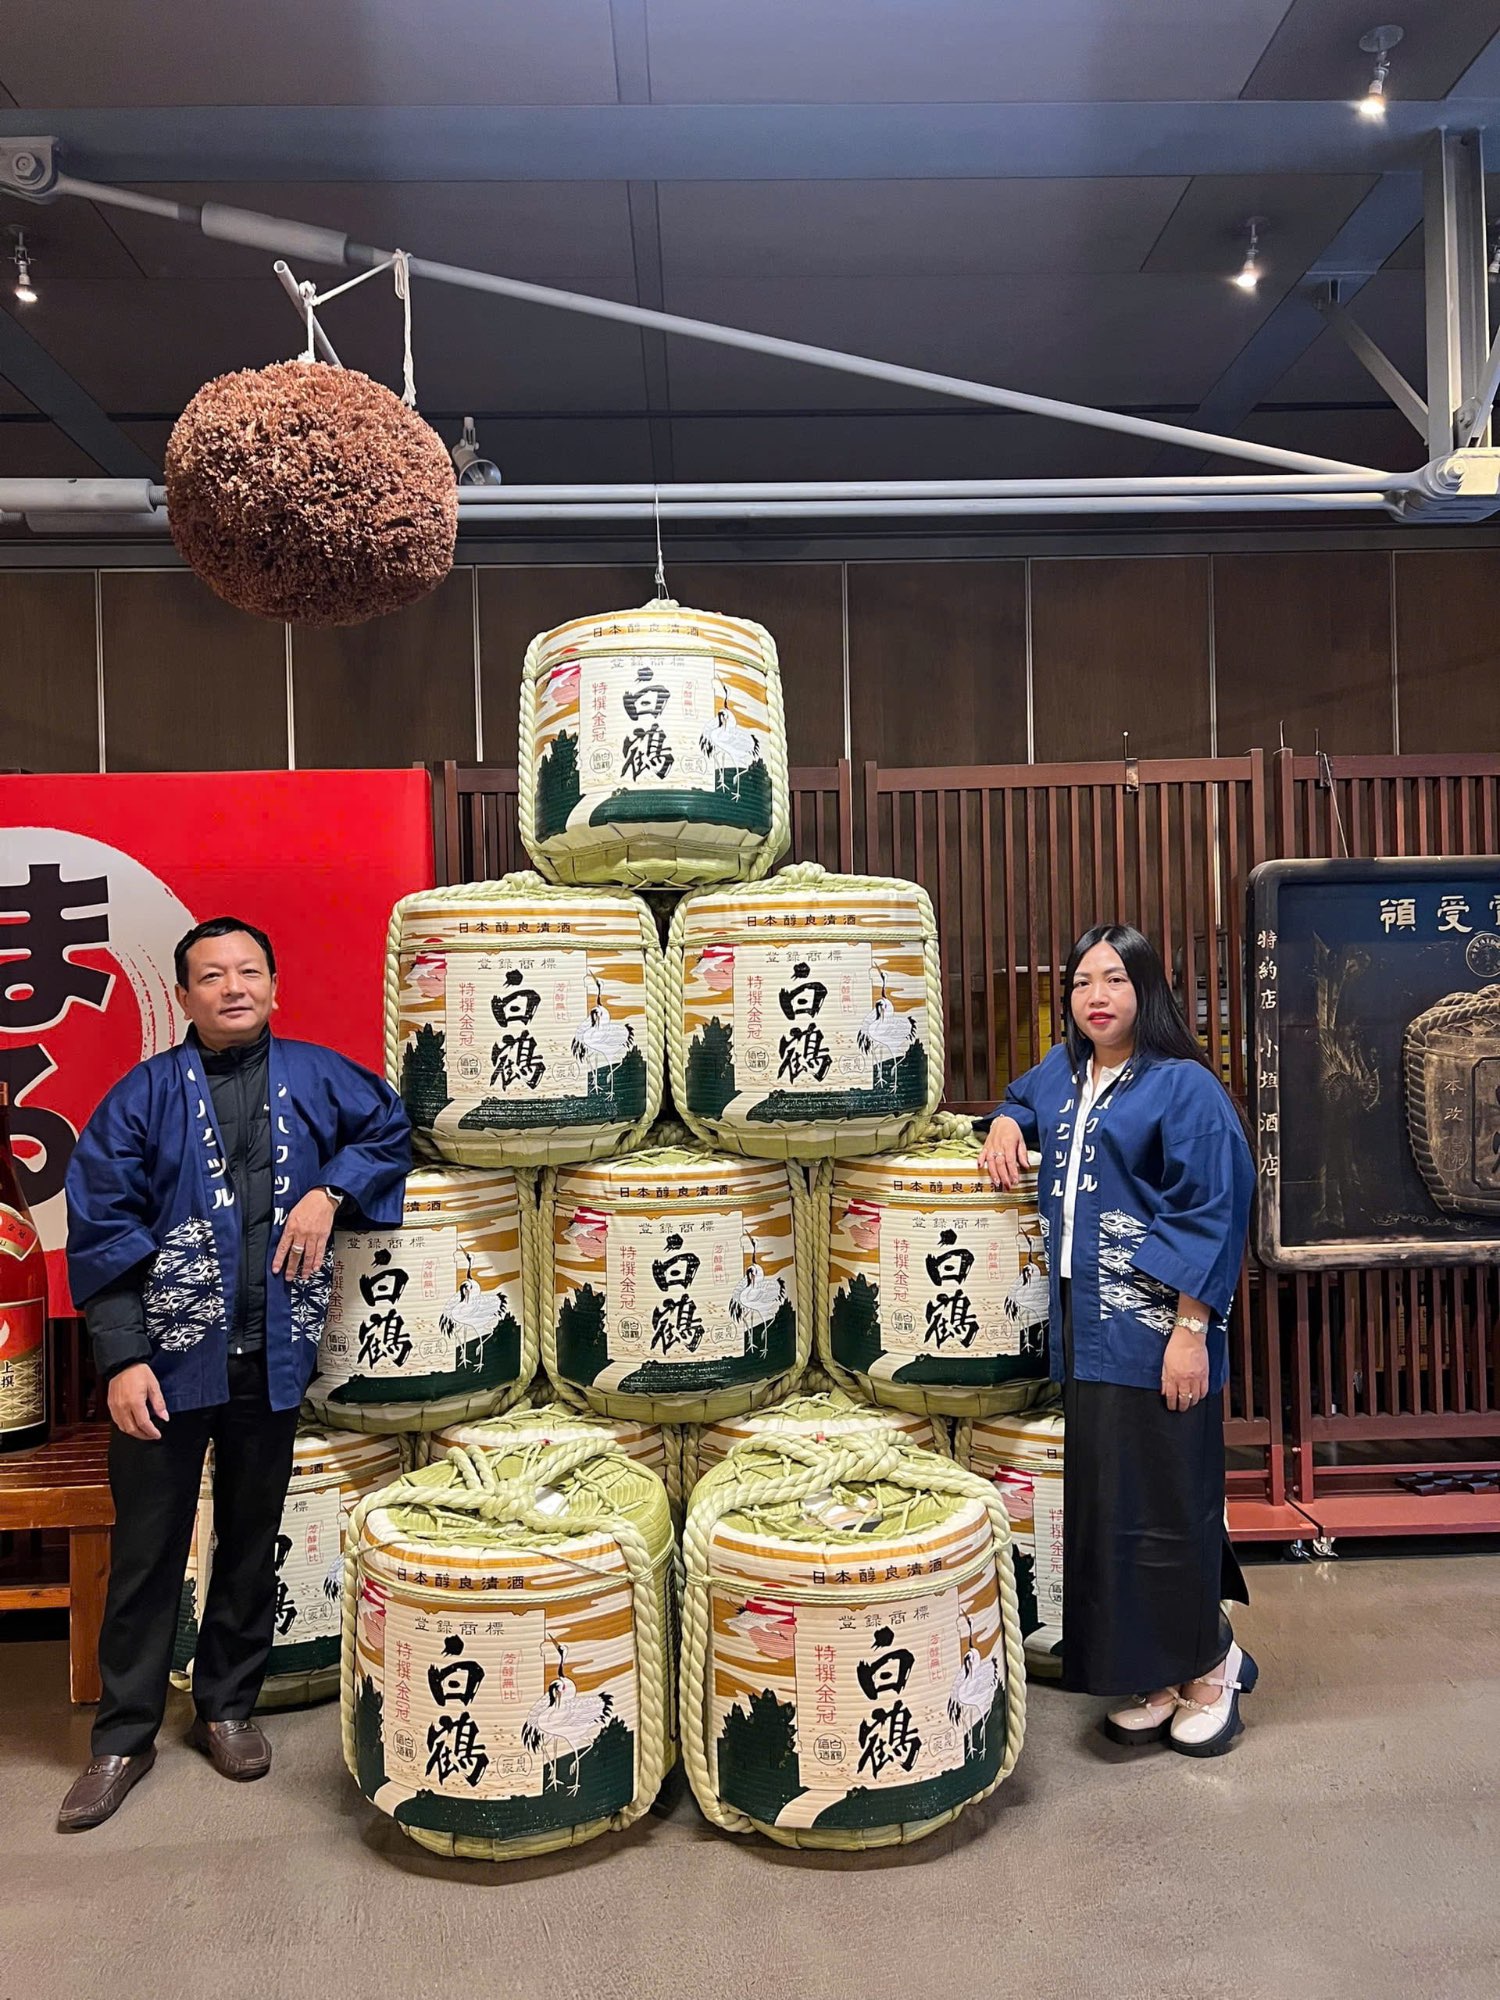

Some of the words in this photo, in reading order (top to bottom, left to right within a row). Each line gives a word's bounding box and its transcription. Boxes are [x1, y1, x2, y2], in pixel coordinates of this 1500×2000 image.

[591, 681, 608, 743] 特撰金冠
[620, 667, 674, 782] 白鶴
[458, 921, 571, 934] 日本醇良清酒
[747, 914, 857, 927] 日本醇良清酒
[458, 982, 476, 1047] 特撰金冠
[490, 969, 546, 1092] 白鶴
[747, 975, 763, 1040] 特撰金冠
[777, 962, 833, 1085] 白鶴
[620, 1184, 729, 1198] 日本醇良清酒
[620, 1246, 637, 1311] 特撰金冠
[650, 1234, 705, 1355] 白鶴
[893, 1238, 910, 1301] 特撰金冠
[924, 1229, 980, 1349] 白鶴
[356, 1248, 413, 1369] 白鶴
[397, 1567, 525, 1590] 日本醇良清酒
[812, 1557, 943, 1585] 日本醇良清酒
[414, 1615, 505, 1636] 登録商標
[838, 1605, 930, 1631] 登録商標
[395, 1640, 413, 1721] 特撰金冠
[502, 1652, 517, 1702] 芳醇無比
[814, 1644, 837, 1725] 特撰金冠
[857, 1626, 922, 1780] 白鶴
[425, 1634, 490, 1787] 白鶴
